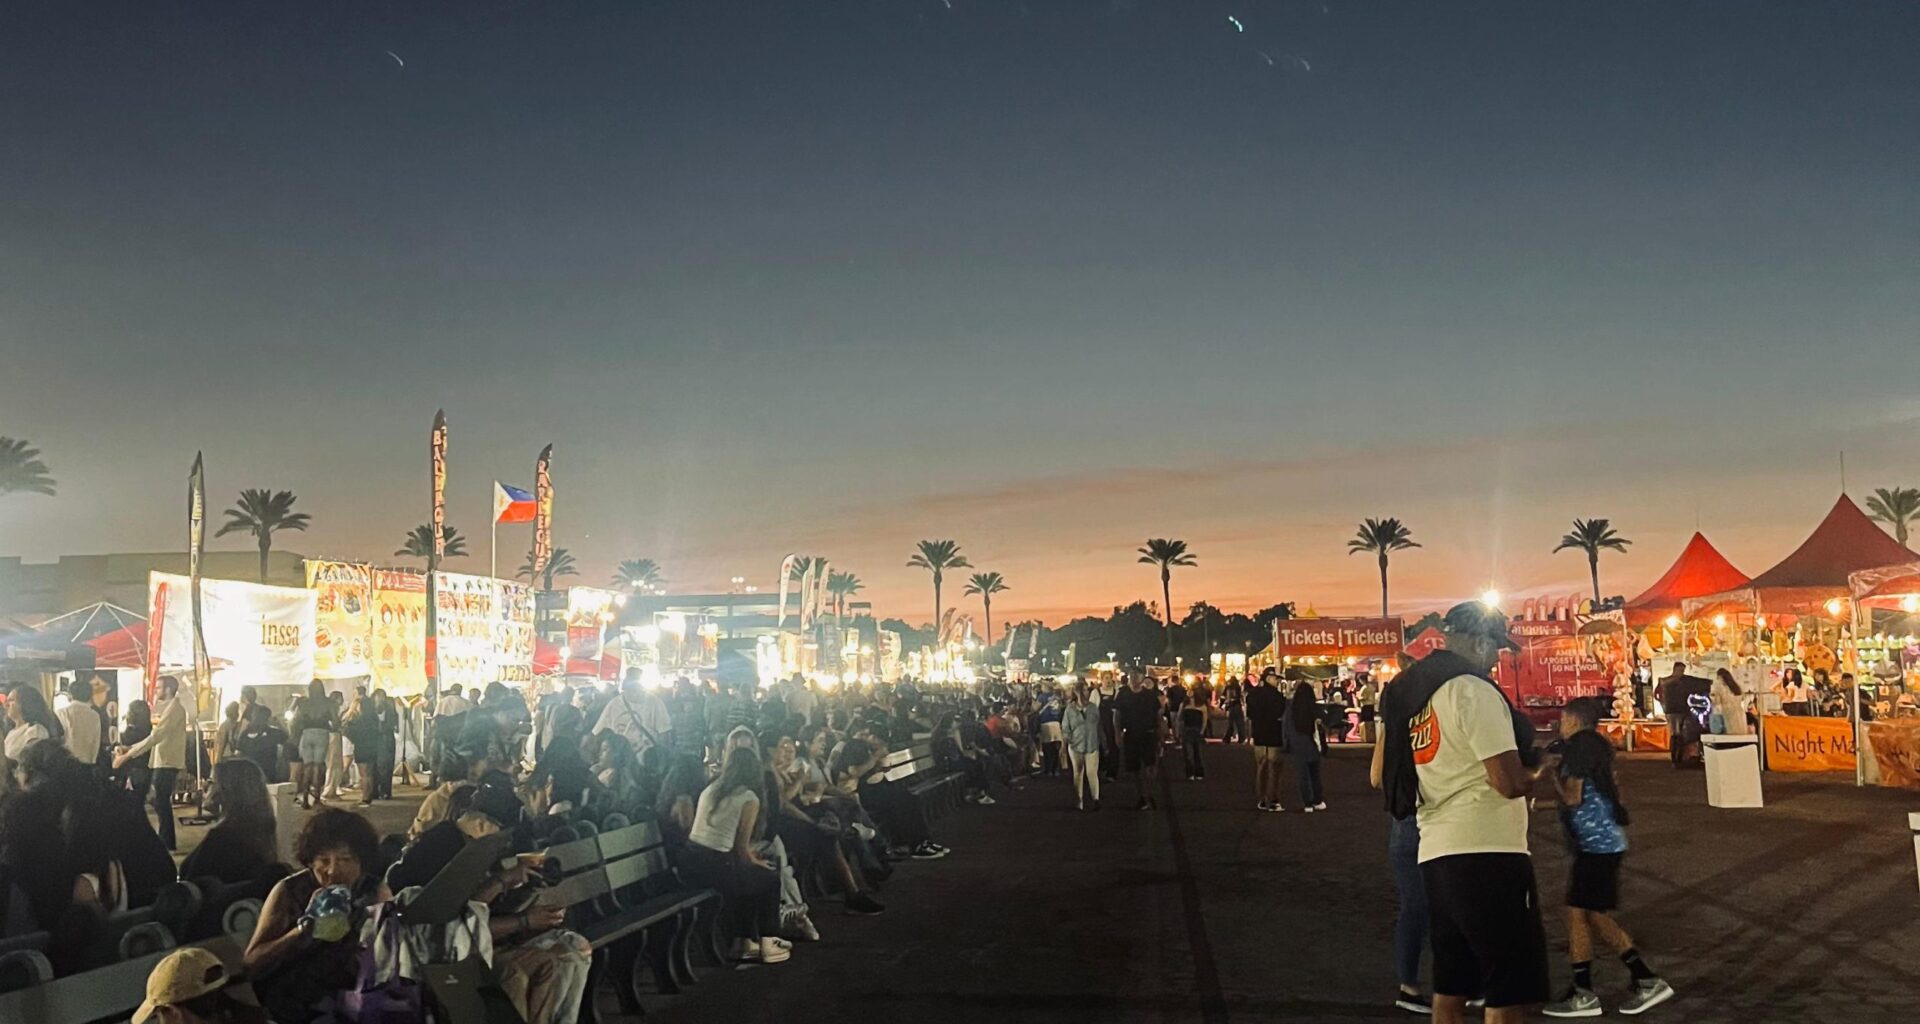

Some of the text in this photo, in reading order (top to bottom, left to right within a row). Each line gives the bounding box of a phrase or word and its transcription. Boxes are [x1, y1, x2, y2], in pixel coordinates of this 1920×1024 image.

[261, 613, 300, 647] inssa
[1281, 629, 1398, 645] Tickets Tickets
[1775, 730, 1825, 760] Night
